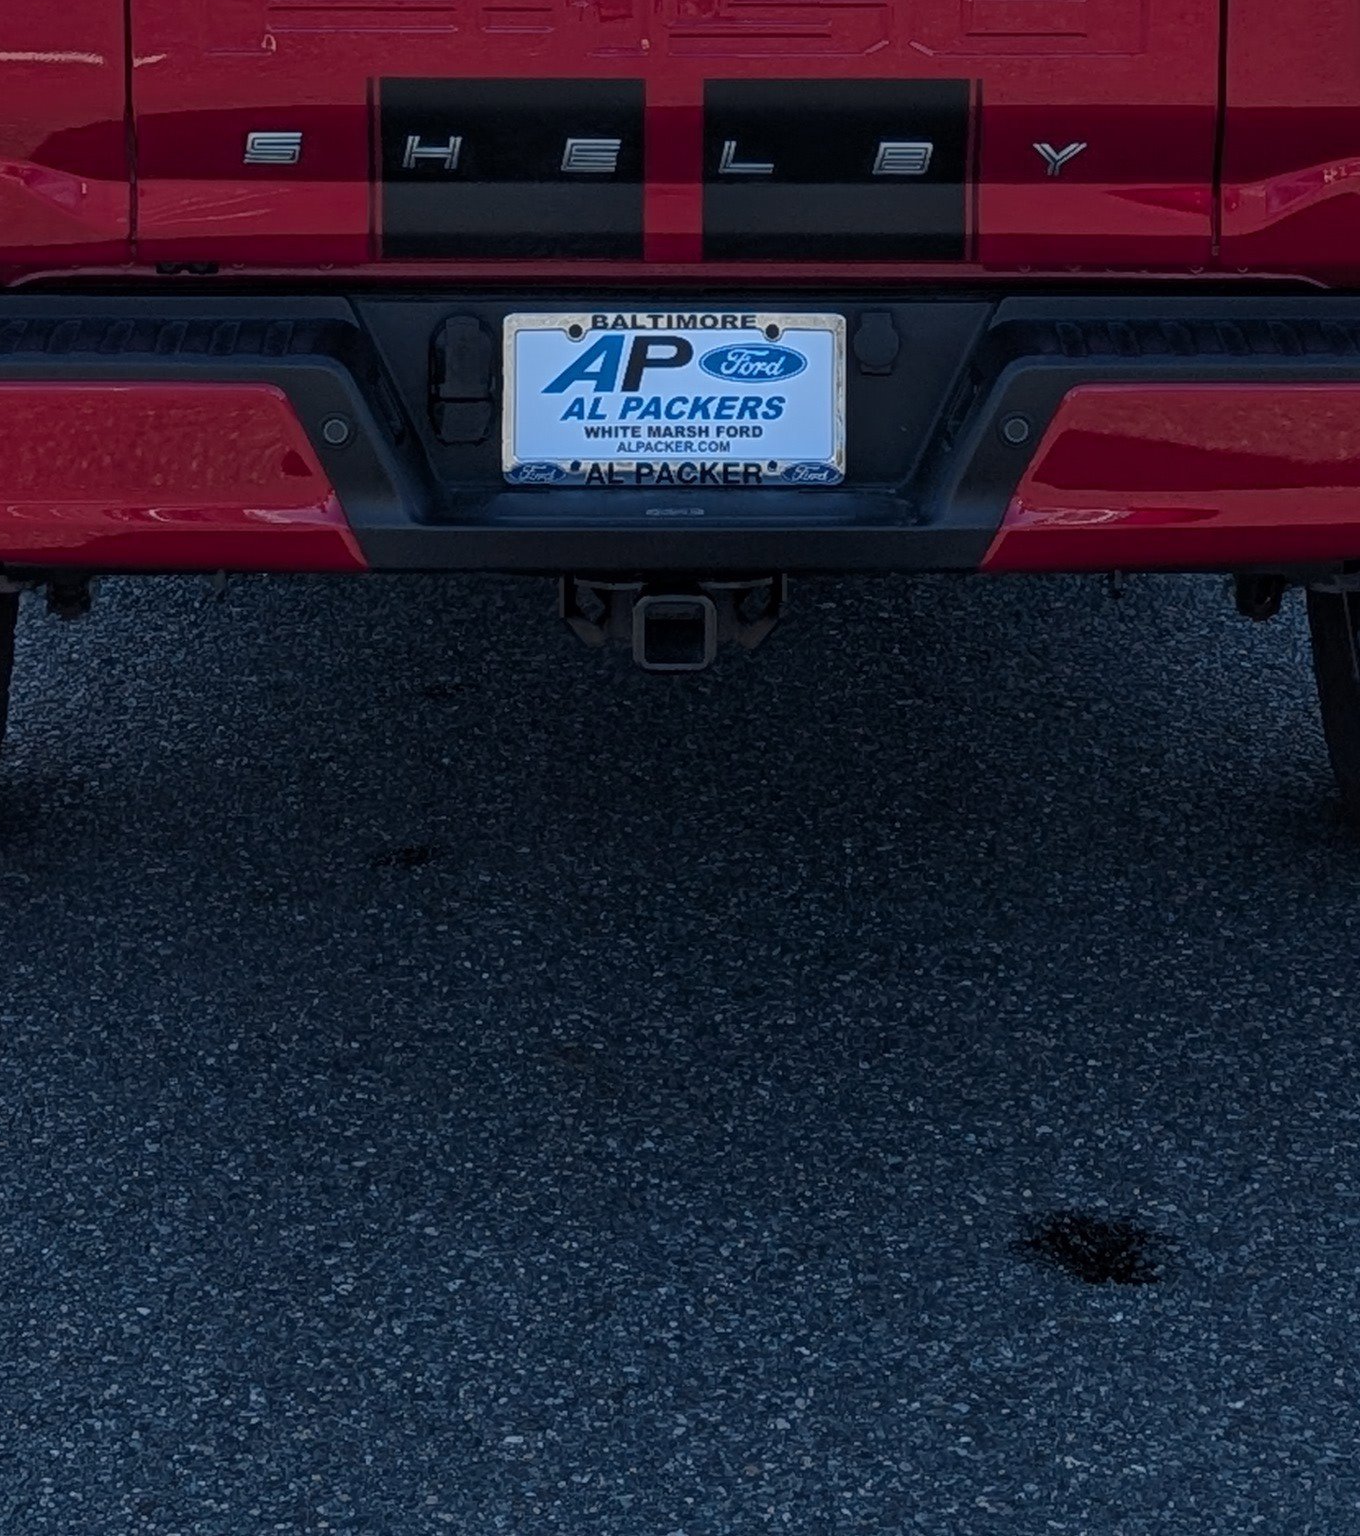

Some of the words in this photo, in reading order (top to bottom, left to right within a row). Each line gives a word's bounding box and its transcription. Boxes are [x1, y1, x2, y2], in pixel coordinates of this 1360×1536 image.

[243, 131, 1087, 176] SHELBY
[591, 314, 757, 329] BALTIMORE
[541, 334, 694, 393] AP
[720, 350, 784, 377] Ford
[560, 397, 608, 421] AL
[619, 396, 785, 421] PACKERS
[584, 425, 640, 438] WHITE
[647, 425, 709, 438] MARSH
[716, 425, 763, 438] FORD
[617, 440, 730, 453] ALPACKER.COM
[585, 463, 624, 484] AL
[635, 461, 763, 484] PACKER
